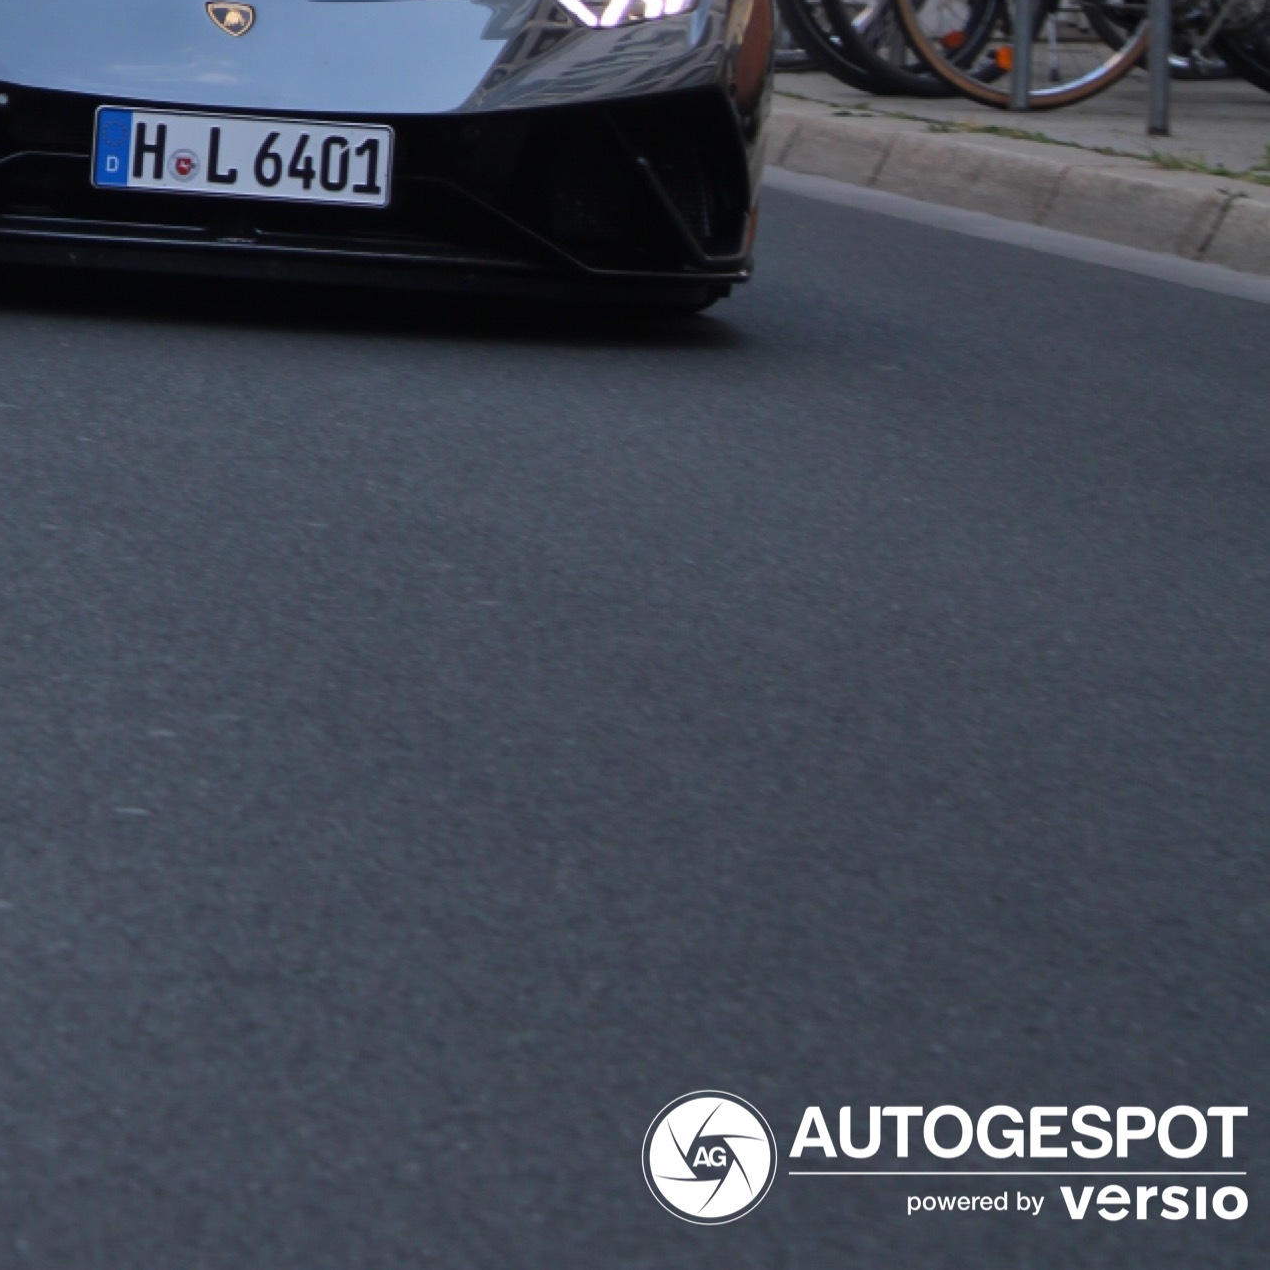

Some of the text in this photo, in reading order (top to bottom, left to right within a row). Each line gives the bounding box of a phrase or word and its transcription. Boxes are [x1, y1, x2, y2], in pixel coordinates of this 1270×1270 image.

[106, 155, 120, 172] D
[132, 122, 382, 195] H L 6401
